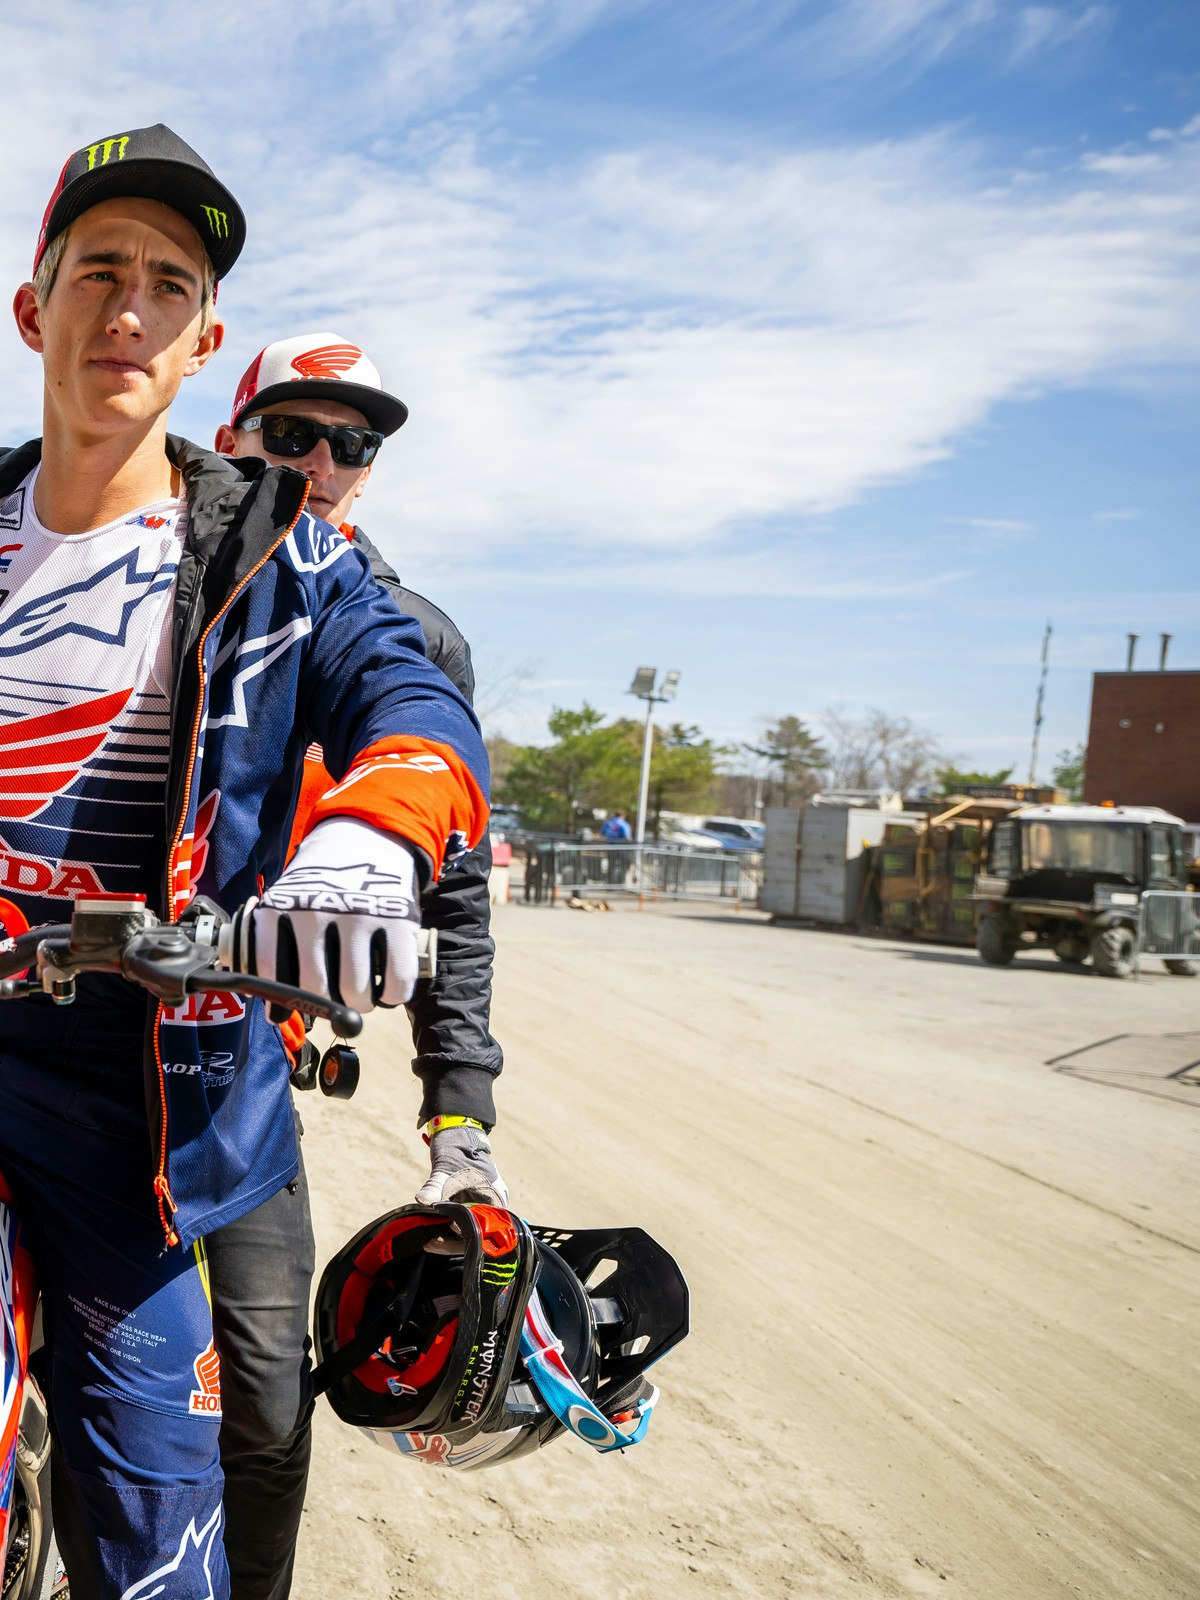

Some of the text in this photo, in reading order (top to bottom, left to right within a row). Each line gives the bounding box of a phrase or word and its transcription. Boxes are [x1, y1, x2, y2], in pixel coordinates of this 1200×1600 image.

[162, 1063, 202, 1076] LOP
[94, 1297, 137, 1319] RACE USE ONLY
[74, 1304, 105, 1328] ESTABLISHED
[142, 1338, 158, 1348] ITALY
[88, 1321, 114, 1339] DESIGNED
[121, 1337, 137, 1348] U.S.A.
[99, 1313, 133, 1333] MOTOCROSS
[133, 1328, 149, 1339] RACE
[150, 1333, 167, 1343] WEAR
[83, 1332, 93, 1342] ONE
[109, 1347, 121, 1357] ONE
[122, 1352, 141, 1363] VISION
[454, 1345, 479, 1407] ENERGY
[460, 1328, 498, 1424] MONSTER
